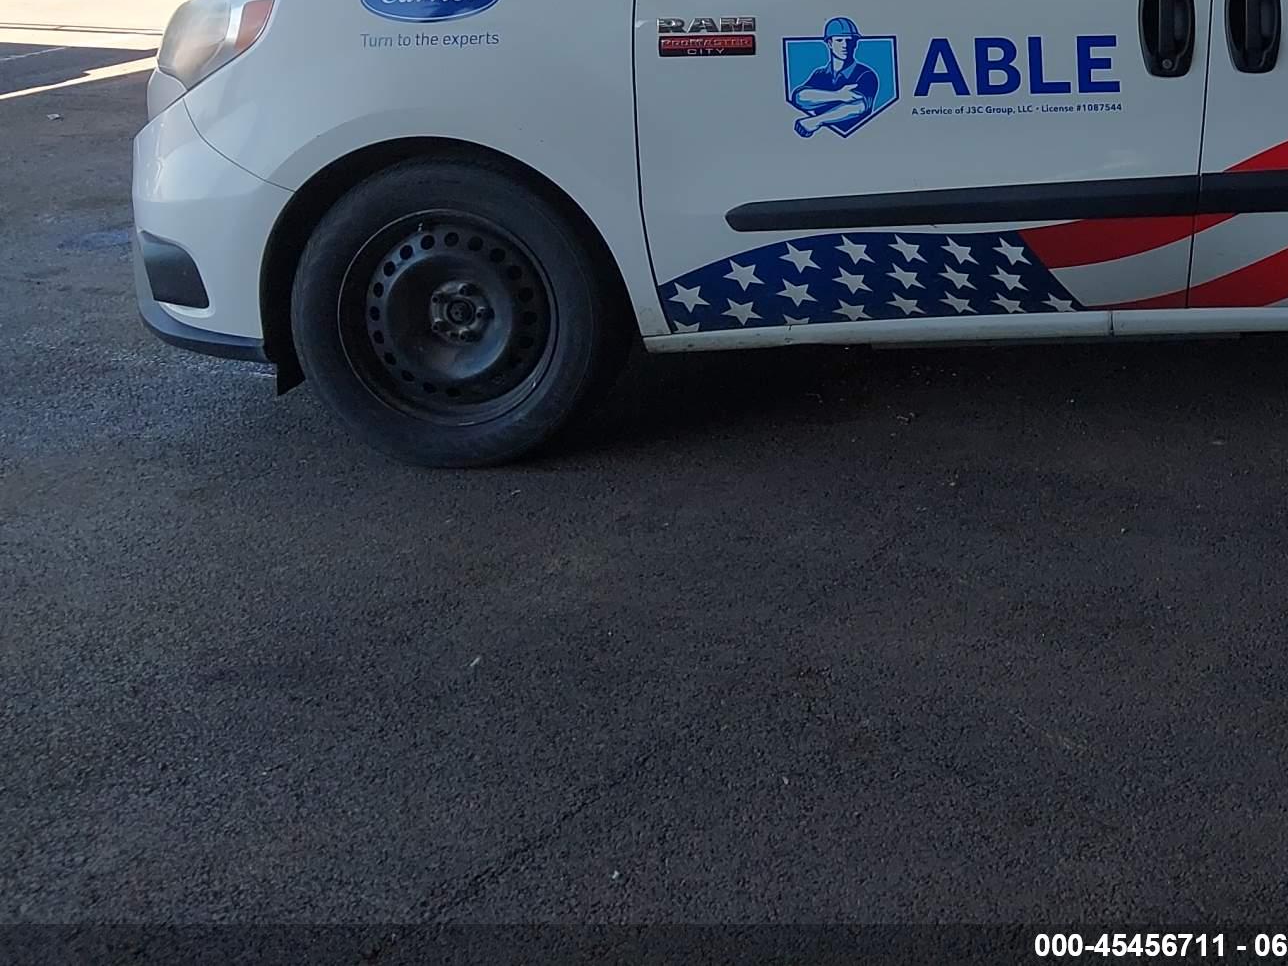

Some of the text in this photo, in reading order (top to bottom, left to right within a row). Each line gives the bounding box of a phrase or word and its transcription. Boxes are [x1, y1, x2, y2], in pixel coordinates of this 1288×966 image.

[657, 17, 756, 34] RAM
[360, 32, 500, 49] Turn to the experts
[913, 35, 1121, 97] ABLE
[920, 106, 953, 115] Service
[954, 106, 965, 115] of
[966, 106, 984, 114] J3C
[985, 105, 1016, 115] Group,
[1017, 105, 1033, 113] LLC
[1041, 104, 1074, 113] License
[1076, 103, 1122, 112] #1087544
